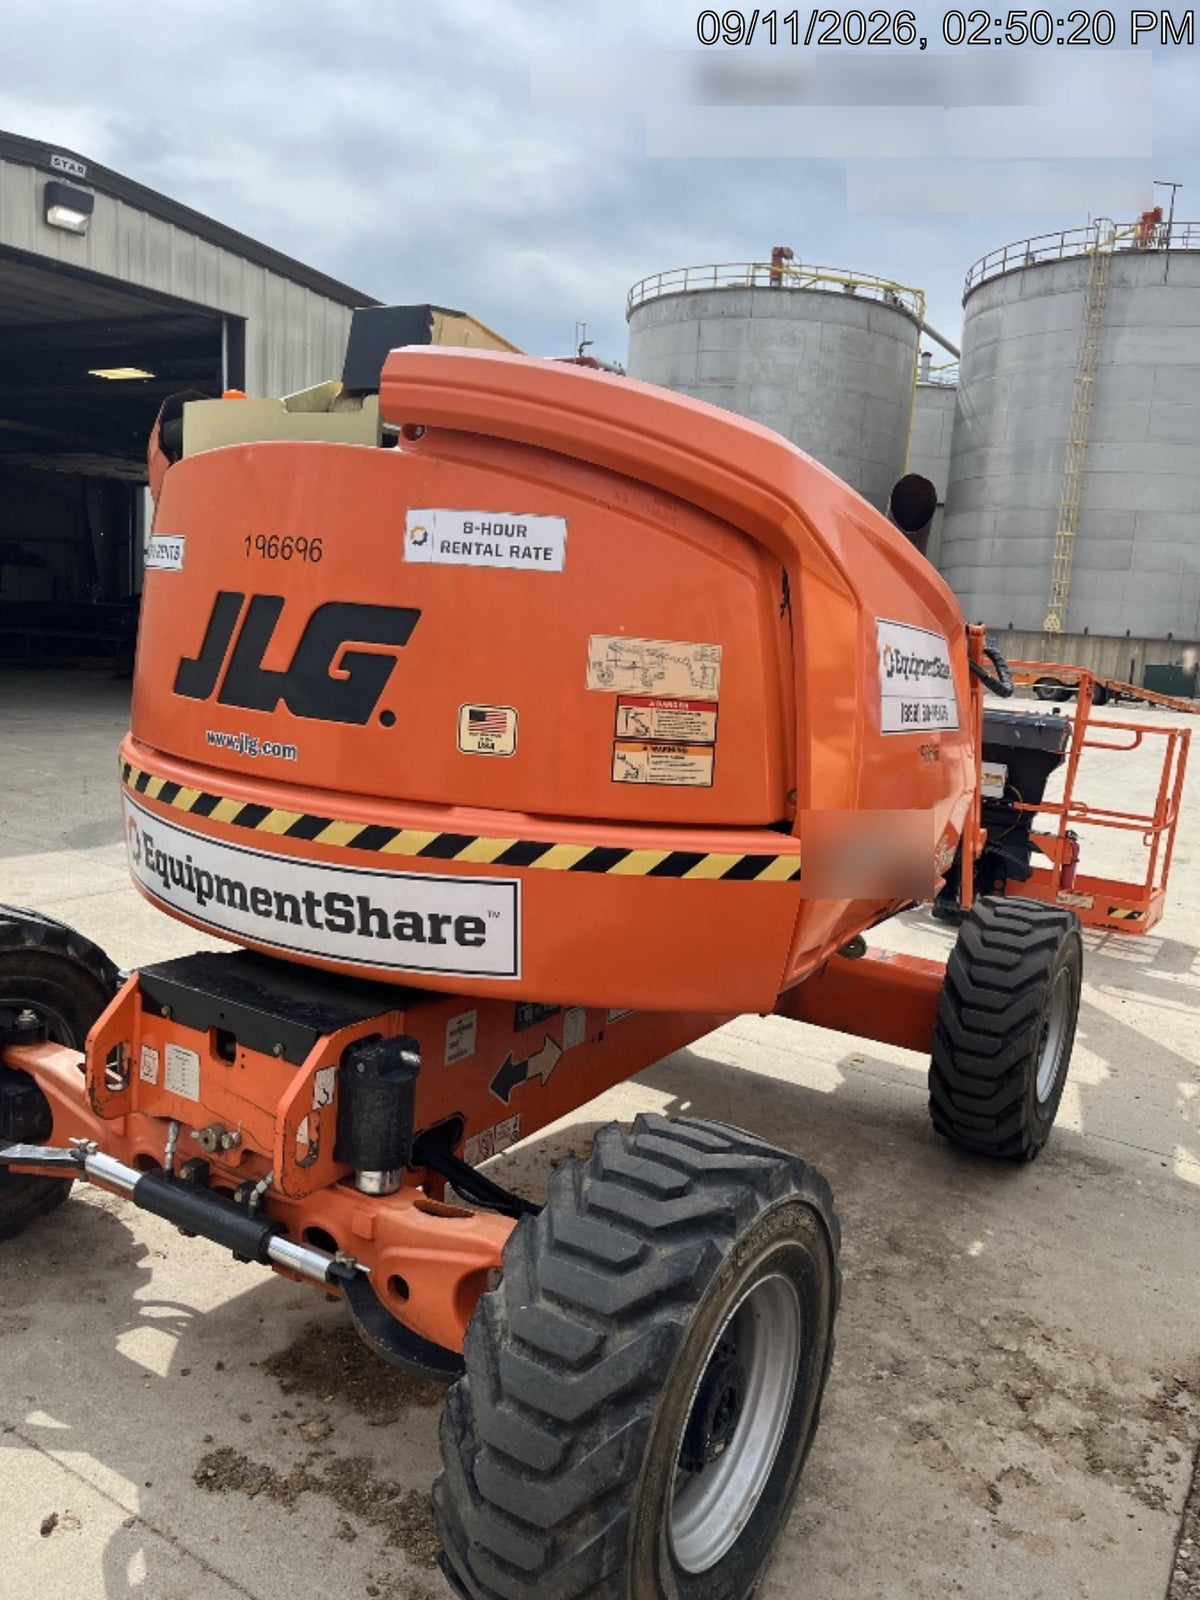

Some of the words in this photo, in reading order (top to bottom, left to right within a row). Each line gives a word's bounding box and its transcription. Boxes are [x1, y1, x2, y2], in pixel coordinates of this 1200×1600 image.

[463, 521, 528, 538] 8-HOUR
[244, 534, 323, 563] 196696
[440, 540, 503, 557] RENTAL
[510, 545, 554, 561] RATE
[206, 730, 298, 761] www.jlg.com
[141, 831, 487, 947] EquipmentShare
